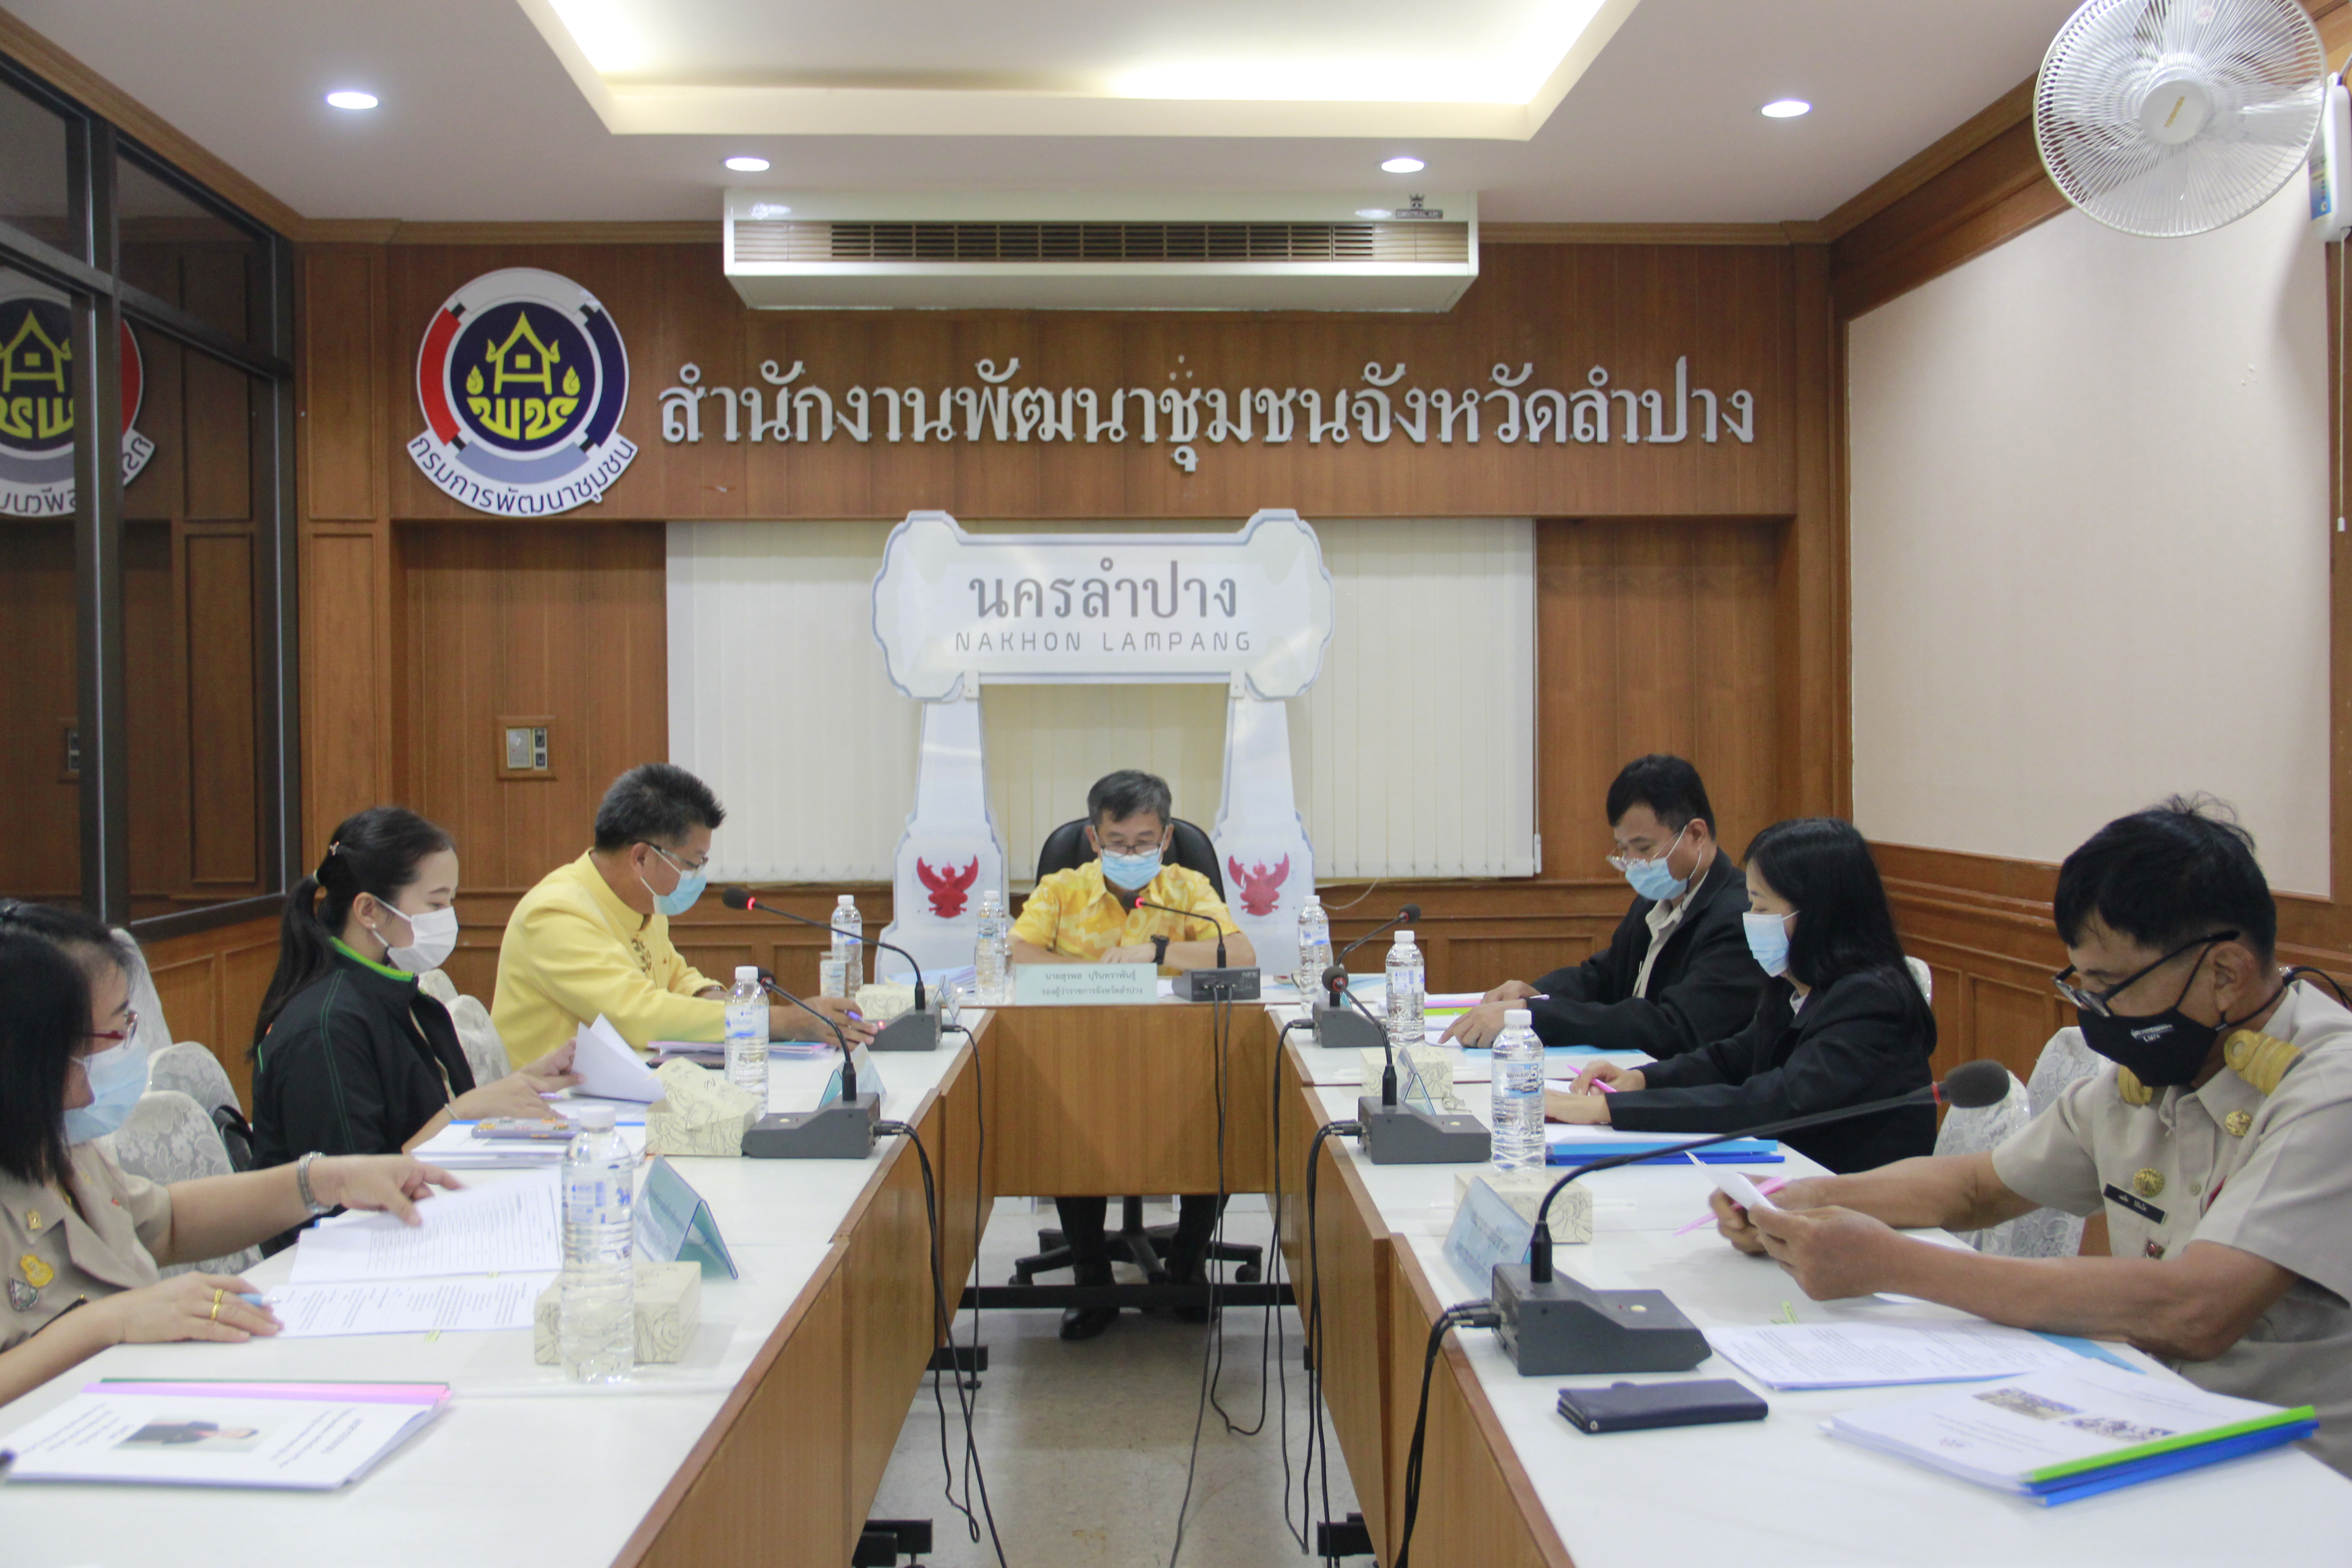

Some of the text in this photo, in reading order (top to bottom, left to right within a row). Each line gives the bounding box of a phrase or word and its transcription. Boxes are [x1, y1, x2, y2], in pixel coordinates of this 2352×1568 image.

[659, 356, 1753, 472] สำนักงานพัฒนาชุมชนจังหวัดลำปาง
[411, 437, 635, 514] กรมการพัฒนาชุมชน
[969, 557, 1237, 618] นครลำปาง
[956, 631, 1250, 652] NAKHON LAMPANG
